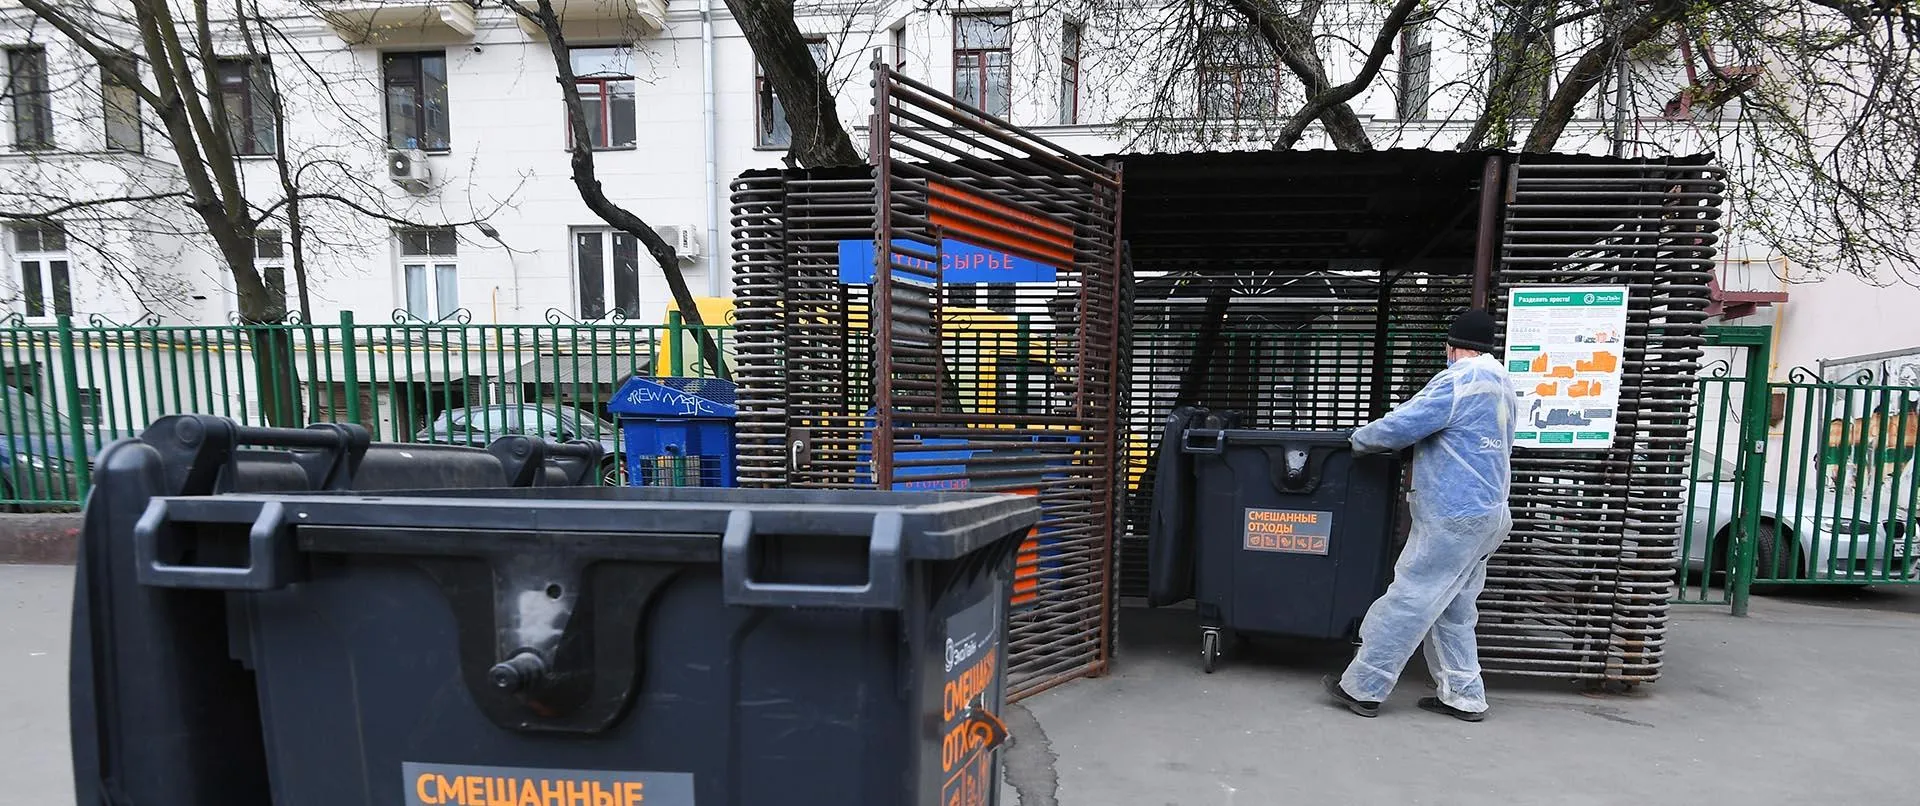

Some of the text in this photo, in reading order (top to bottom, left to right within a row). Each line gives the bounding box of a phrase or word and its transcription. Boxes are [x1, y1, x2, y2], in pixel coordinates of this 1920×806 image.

[1480, 436, 1503, 448] Эко
[1248, 511, 1318, 524] СМЕШАННЫЕ
[1248, 521, 1293, 534] ОТХОДЫ
[416, 773, 645, 806] СМЕШАННЫЕ
